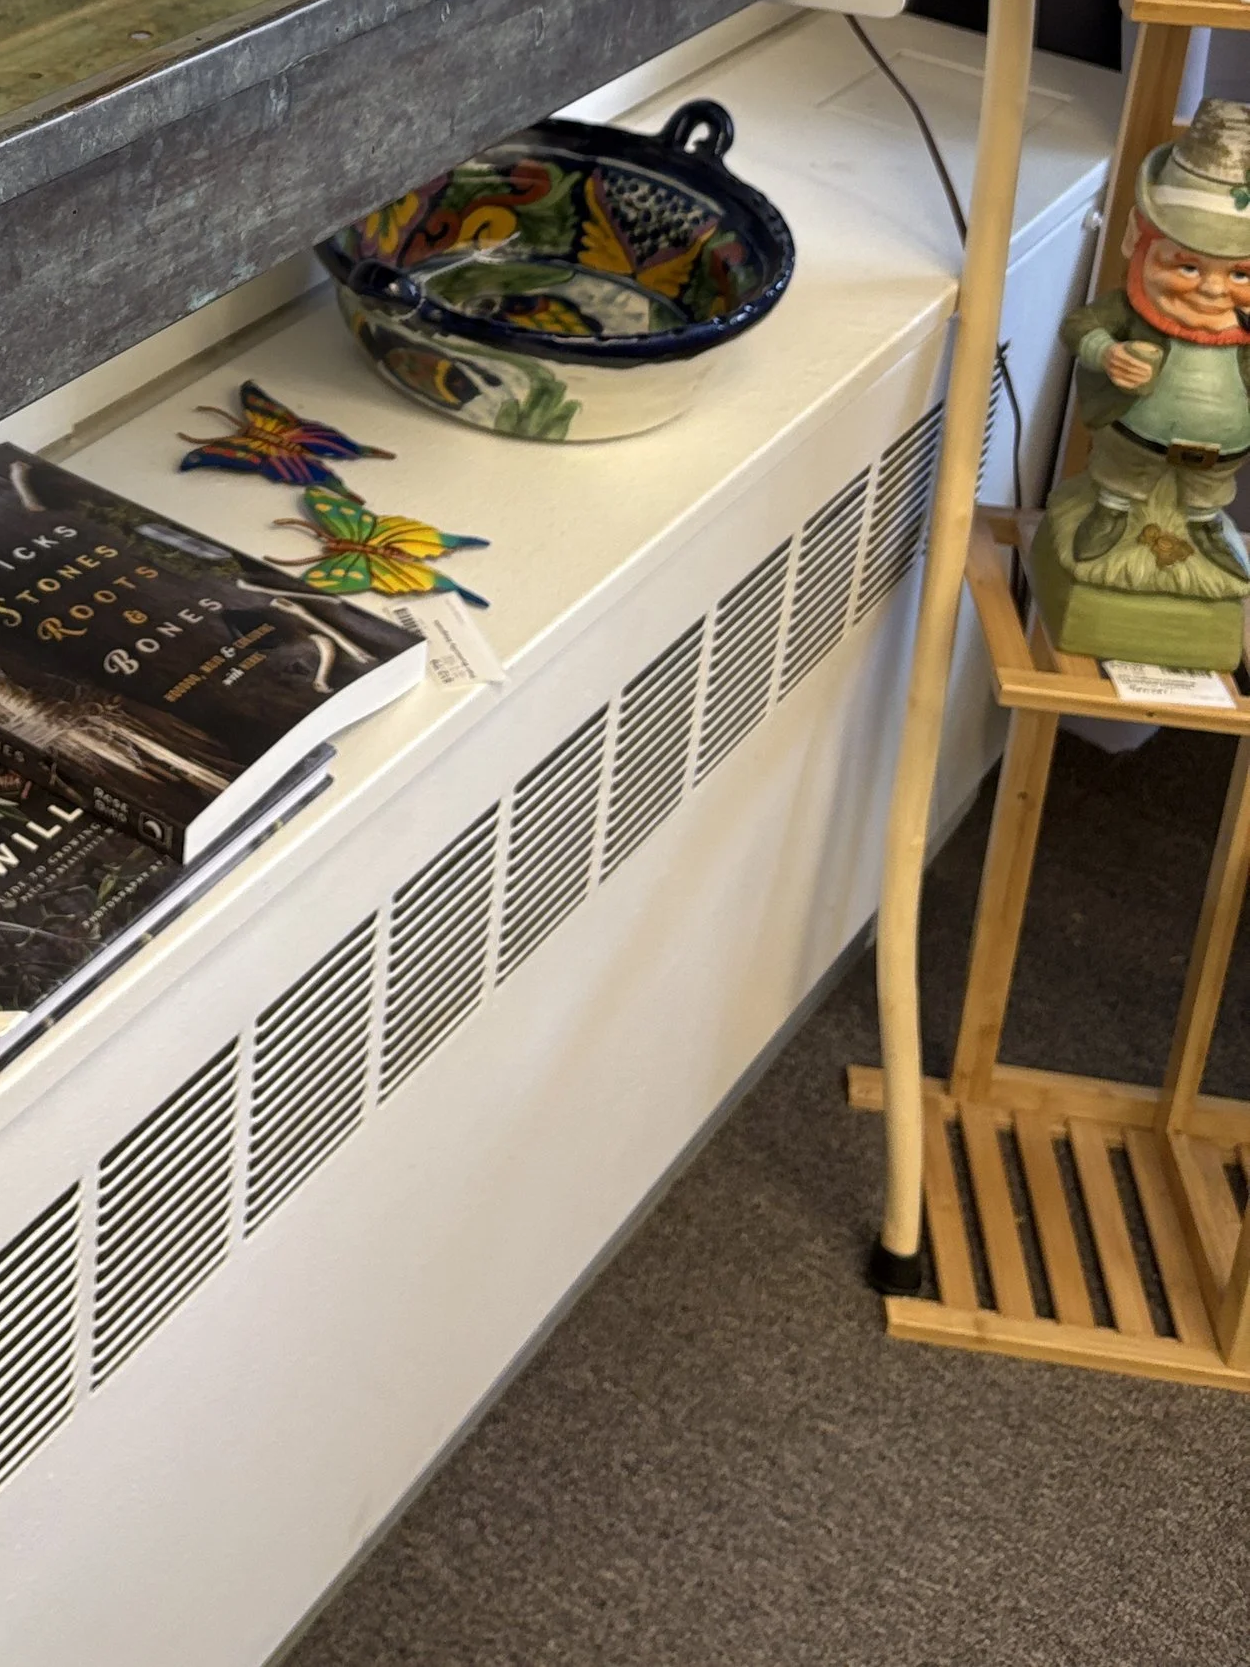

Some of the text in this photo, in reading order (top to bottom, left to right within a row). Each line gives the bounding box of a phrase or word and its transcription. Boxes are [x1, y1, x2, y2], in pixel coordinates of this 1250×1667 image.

[37, 565, 159, 642] ROOTS
[123, 610, 148, 624] &
[103, 597, 223, 675] BONES
[220, 646, 236, 658] &
[48, 823, 101, 864] GROWING
